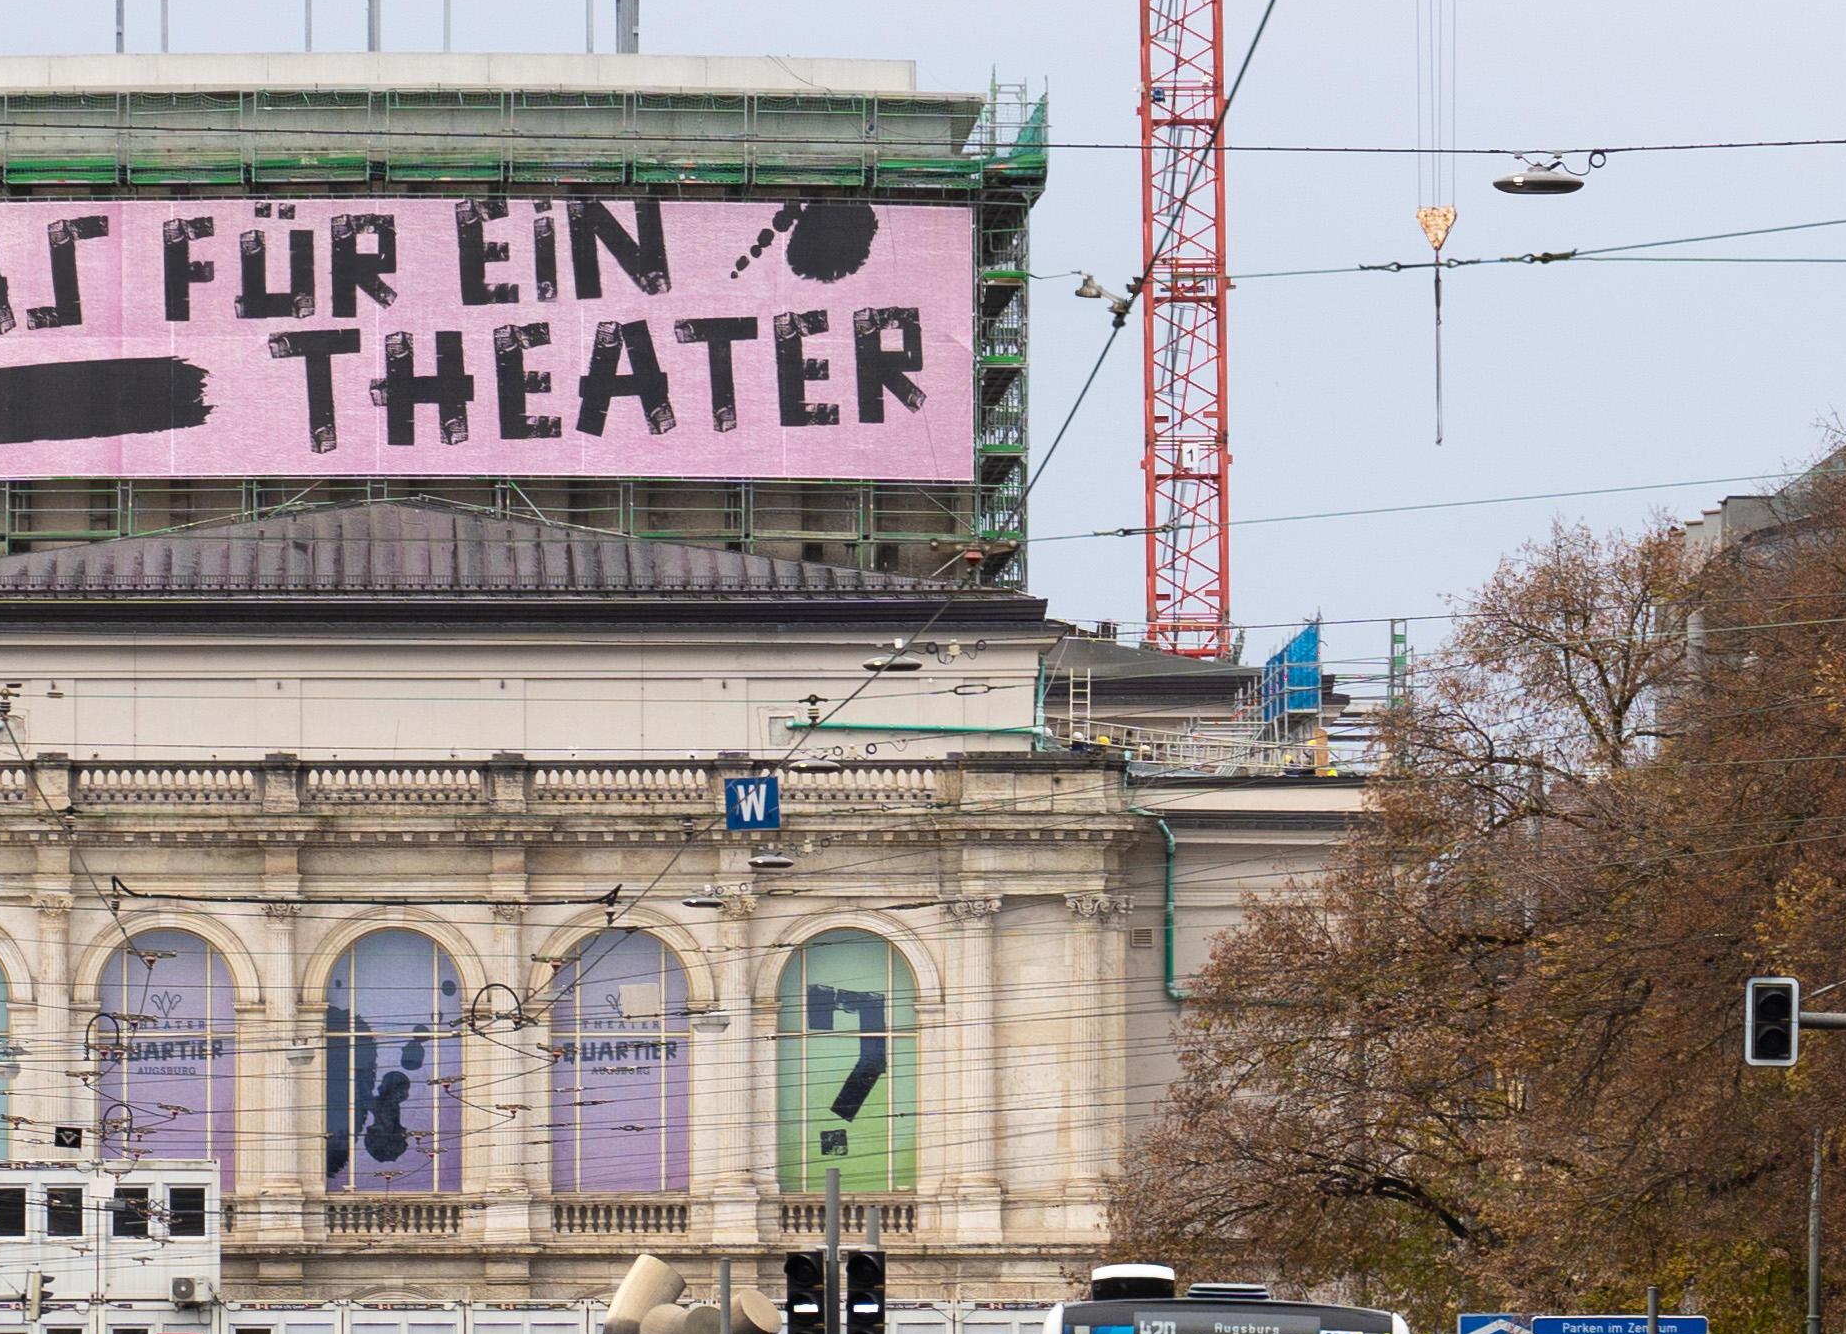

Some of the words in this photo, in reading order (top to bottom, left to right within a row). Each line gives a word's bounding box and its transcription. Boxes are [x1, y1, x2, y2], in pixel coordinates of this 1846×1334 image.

[163, 201, 397, 323] FÜR
[268, 306, 927, 456] THEATER
[736, 784, 767, 822] W
[138, 1067, 197, 1075] AUGSBURG
[1562, 1323, 1603, 1333] Parken
[1607, 1323, 1622, 1333] im
[1628, 1323, 1678, 1334] Zenum
